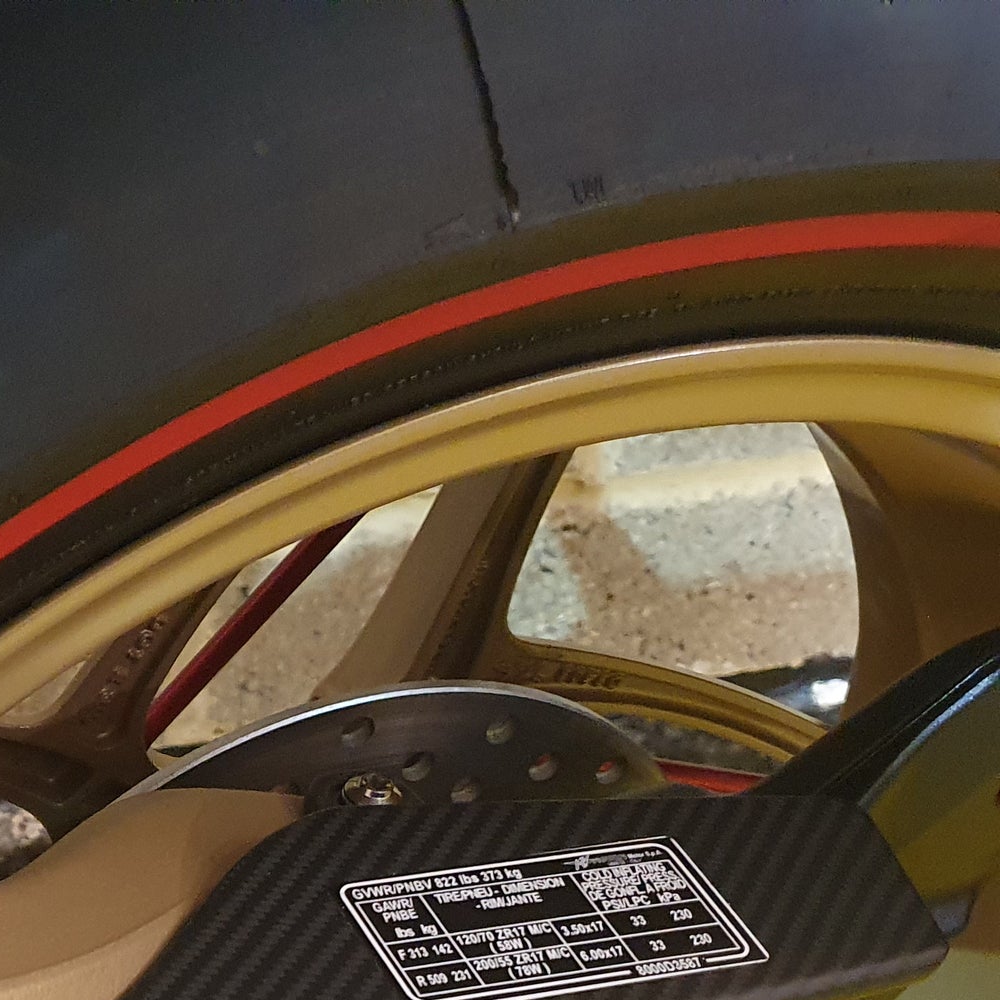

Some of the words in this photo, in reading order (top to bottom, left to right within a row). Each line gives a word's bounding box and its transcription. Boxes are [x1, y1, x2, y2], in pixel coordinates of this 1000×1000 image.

[582, 868, 612, 881] COLD
[611, 863, 666, 878] INFLATING
[352, 879, 432, 900] GVWR/PNBV
[434, 876, 457, 888] 822
[459, 874, 479, 885] lbs
[480, 870, 503, 881] 373
[504, 868, 522, 880] kg
[501, 877, 565, 894] DIMENSION
[588, 890, 606, 901] DE
[654, 879, 687, 892] FROID
[372, 898, 413, 913] GAWR/
[601, 895, 651, 911] PSI/LPC
[657, 891, 681, 903] kPa
[382, 909, 418, 923] PNBE
[630, 915, 647, 926] 33
[670, 908, 692, 921] 230
[395, 927, 415, 938] lbs
[420, 924, 438, 935] kg
[456, 932, 494, 946] 120/70
[495, 926, 526, 939] ZR17
[527, 923, 552, 935] M/C
[560, 921, 604, 937] 3.50x17
[649, 940, 666, 951] 33
[689, 933, 712, 946] 230
[397, 949, 406, 960] F
[407, 946, 429, 959] 313
[432, 943, 453, 955] 142
[473, 957, 513, 971] 200/55
[514, 951, 544, 964] ZR17
[545, 947, 570, 960] M/C
[580, 946, 624, 962] 6.00x17
[416, 975, 427, 987] R
[427, 973, 448, 985] 509
[451, 969, 472, 981] 231
